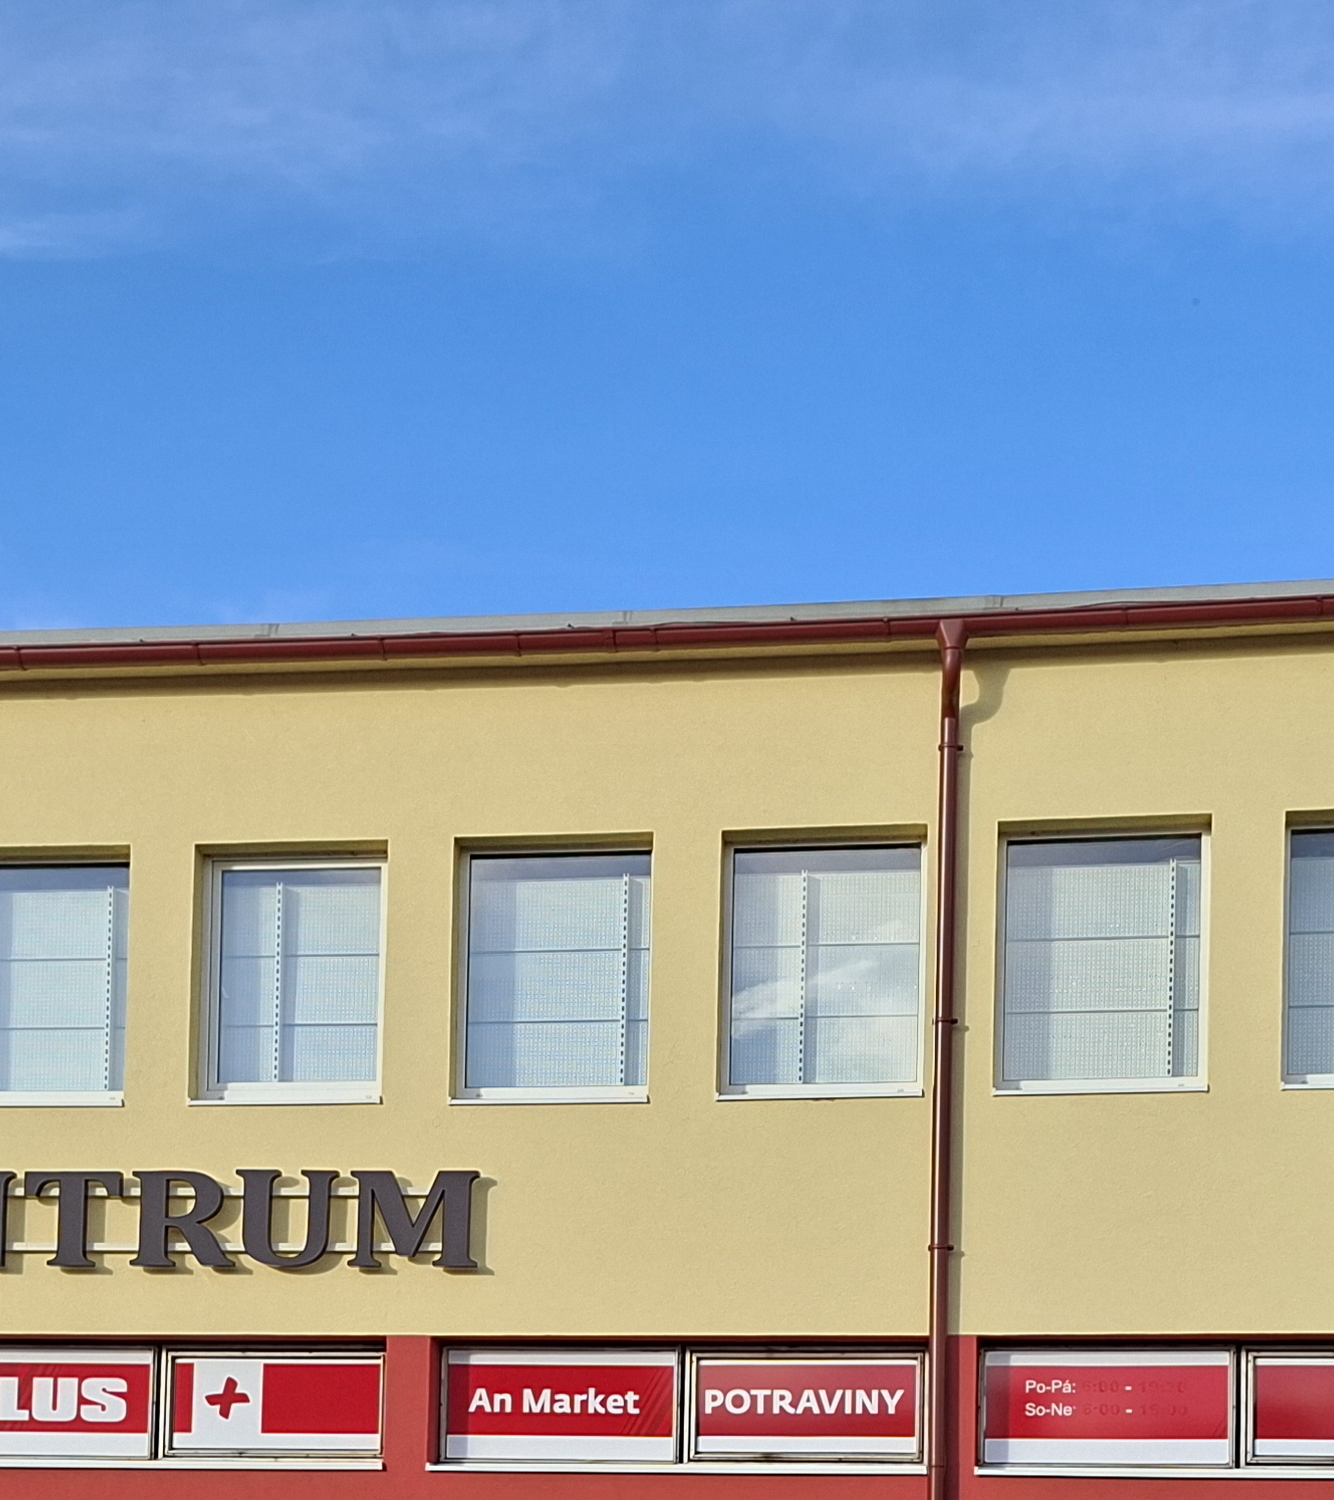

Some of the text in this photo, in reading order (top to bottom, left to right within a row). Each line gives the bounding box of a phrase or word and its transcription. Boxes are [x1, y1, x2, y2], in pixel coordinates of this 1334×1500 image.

[1025, 1379, 1077, 1394] Po-Pá:
[468, 1386, 640, 1415] An Market
[704, 1388, 904, 1415] POTRAVINY
